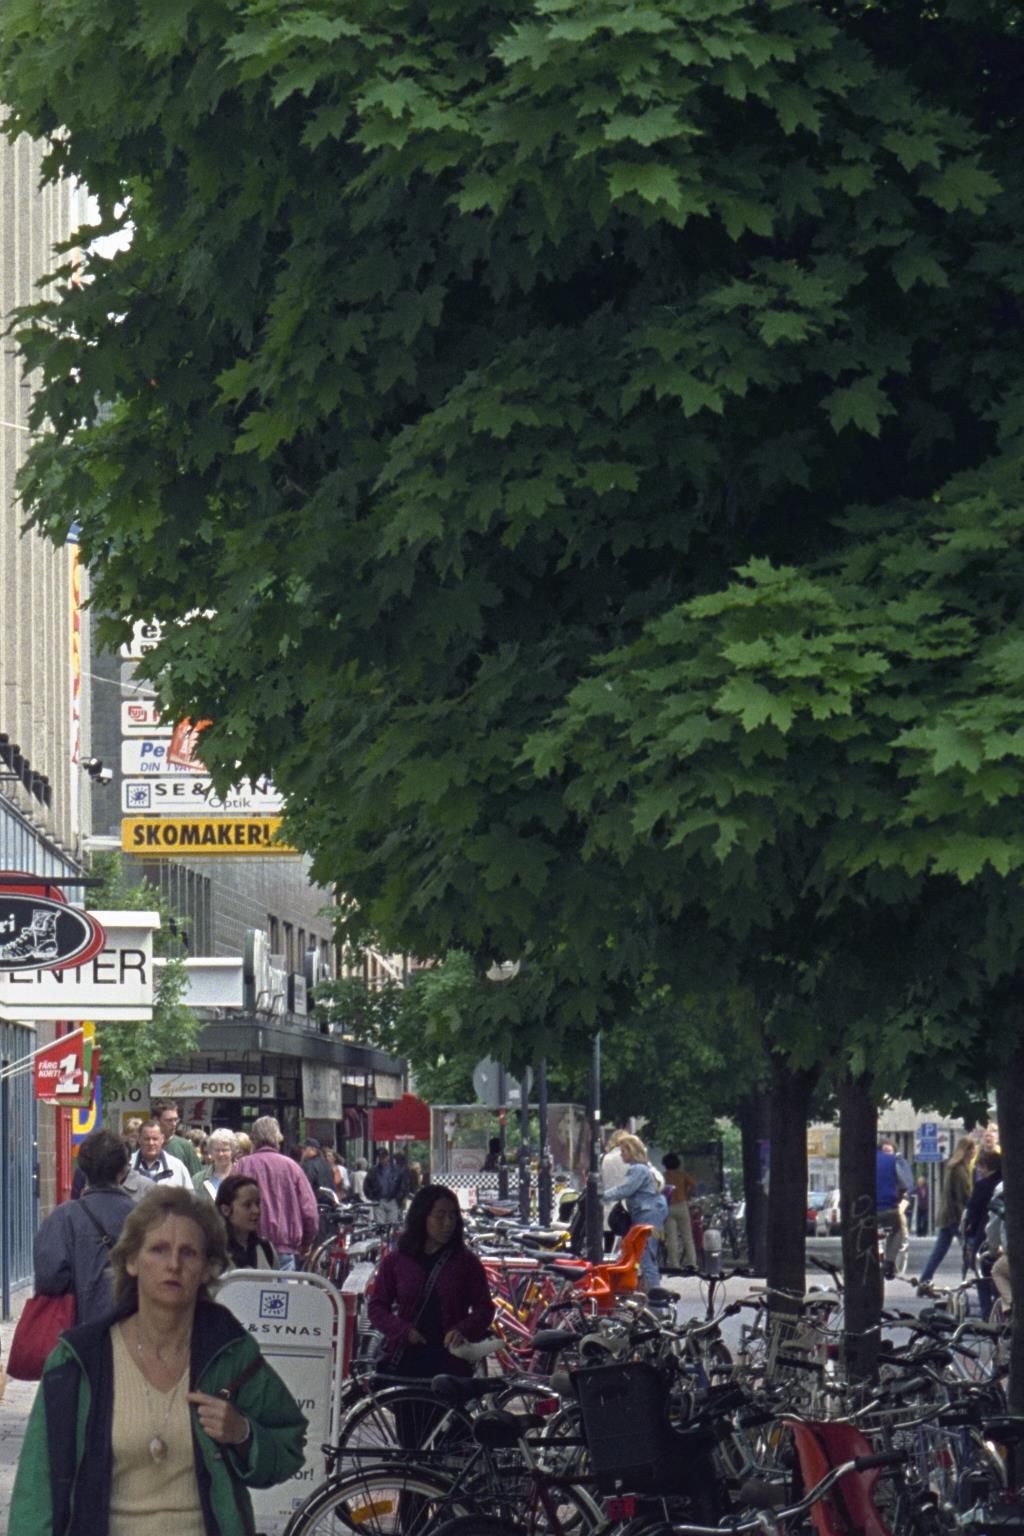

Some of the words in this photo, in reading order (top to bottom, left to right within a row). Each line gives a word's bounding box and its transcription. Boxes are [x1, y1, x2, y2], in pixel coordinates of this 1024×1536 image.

[140, 742, 167, 758] Pe
[209, 797, 252, 810] Optik
[133, 824, 272, 847] SKOMAKERI
[201, 1082, 236, 1094] FOTO
[242, 1324, 322, 1336] &SYNAS
